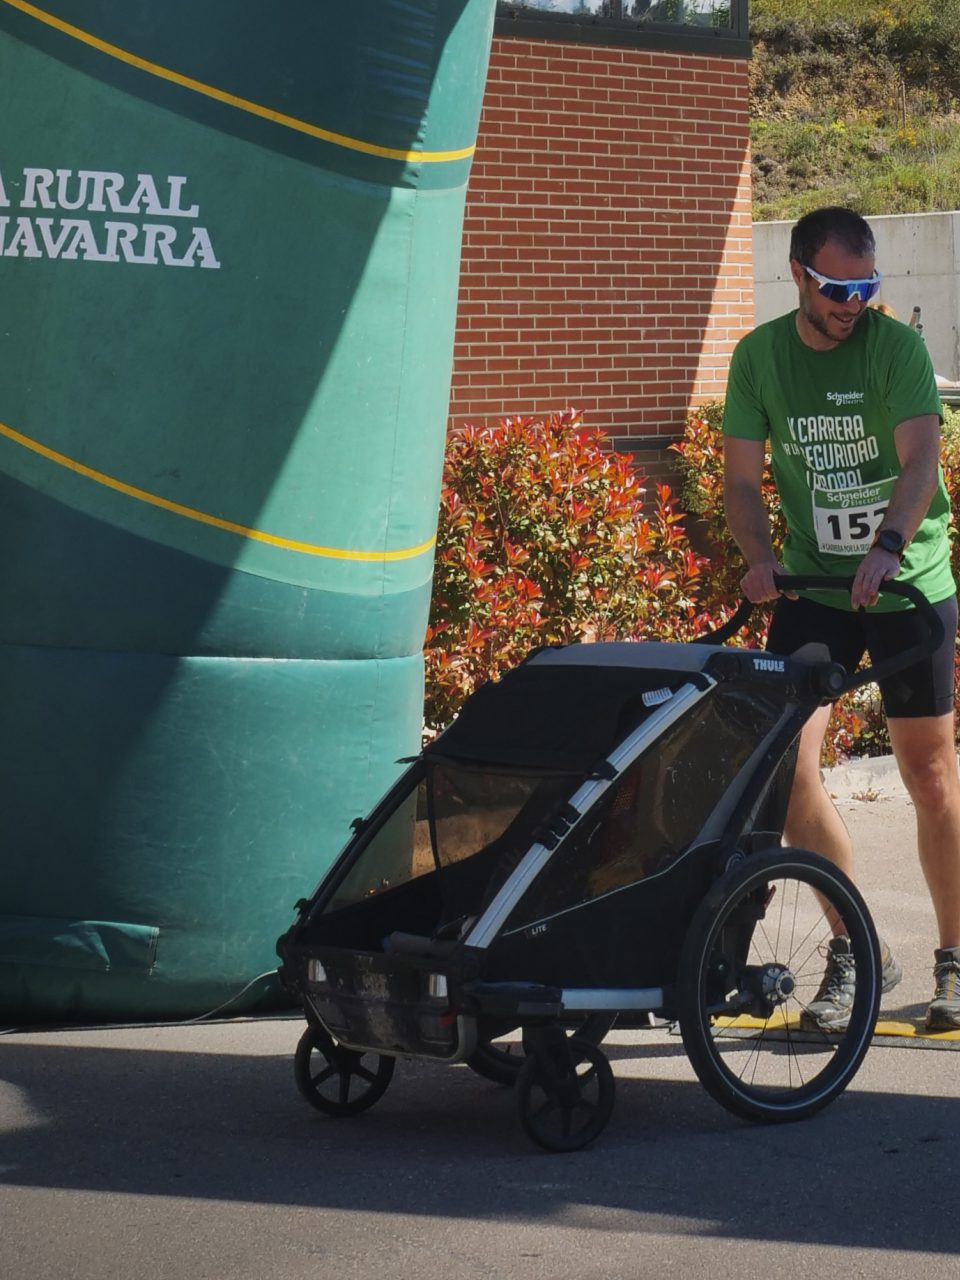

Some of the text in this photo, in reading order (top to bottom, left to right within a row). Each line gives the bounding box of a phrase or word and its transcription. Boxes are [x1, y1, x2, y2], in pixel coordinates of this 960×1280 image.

[20, 168, 199, 218] RURAL
[0, 215, 221, 269] AVARRA
[826, 391, 864, 403] Schneider
[797, 415, 865, 443] CARRERA
[827, 487, 881, 504] Schneider
[753, 658, 785, 672] THULE
